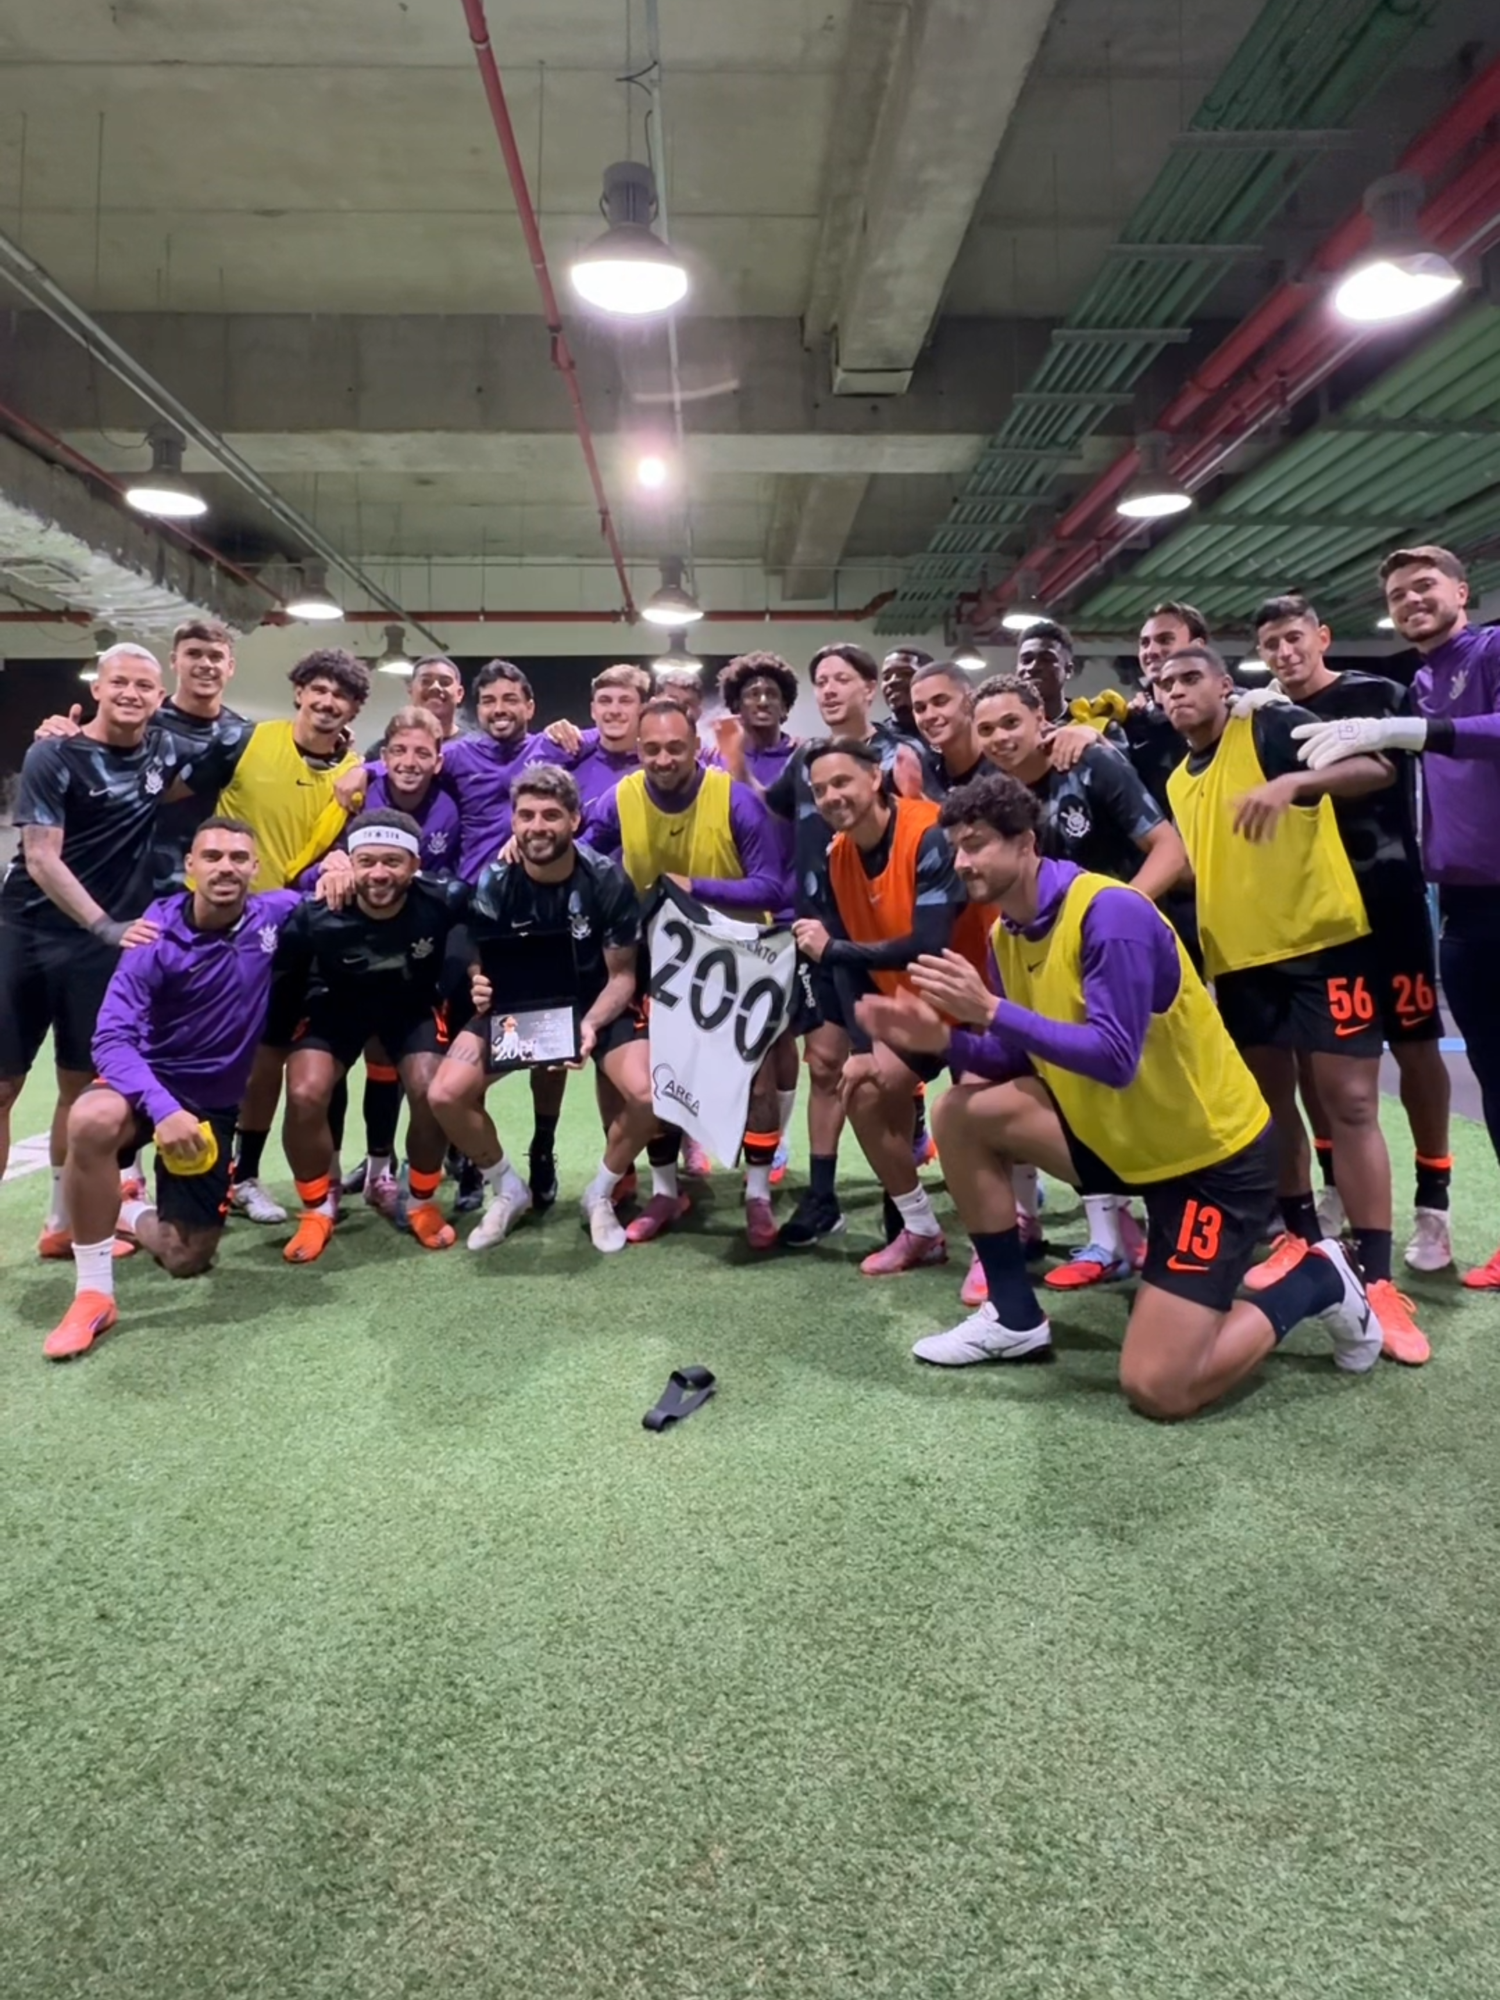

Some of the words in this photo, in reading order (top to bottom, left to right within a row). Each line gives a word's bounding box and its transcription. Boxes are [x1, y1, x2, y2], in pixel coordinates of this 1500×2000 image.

[650, 919, 785, 1063] 200
[1327, 976, 1374, 1020] 56
[1392, 973, 1434, 1012] 26
[662, 1079, 700, 1113] AREA
[1177, 1199, 1221, 1259] 13
